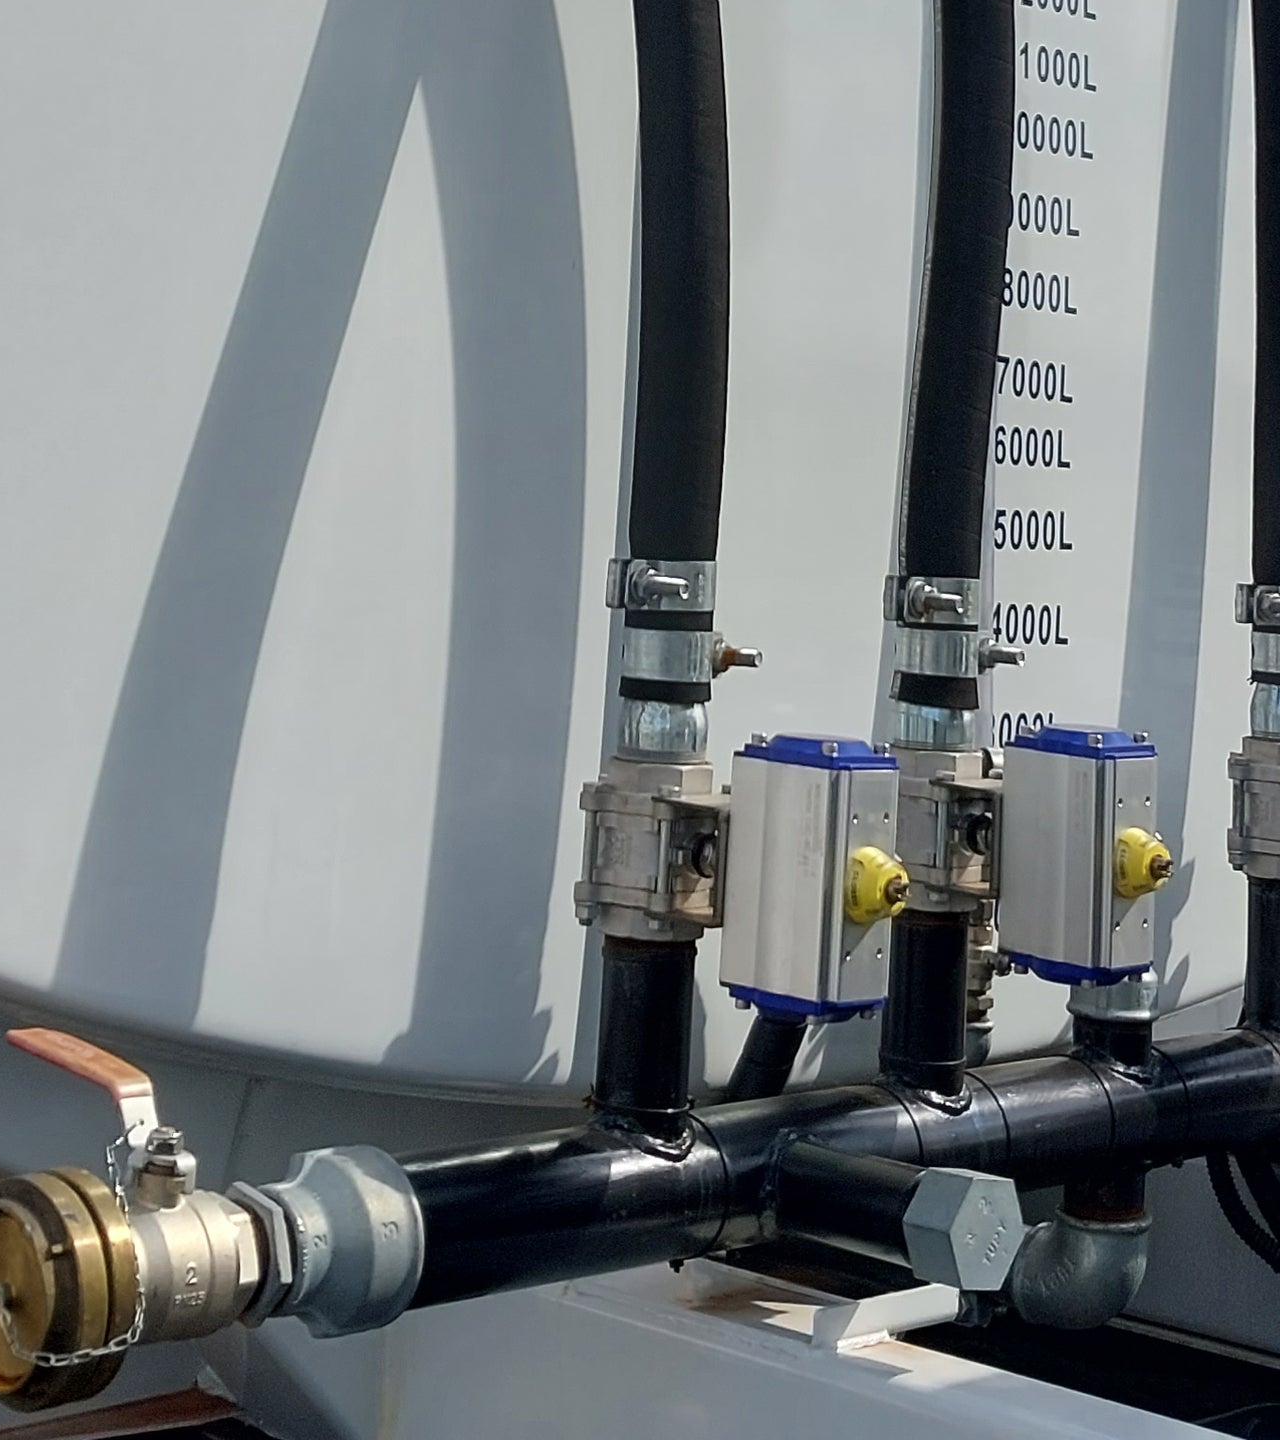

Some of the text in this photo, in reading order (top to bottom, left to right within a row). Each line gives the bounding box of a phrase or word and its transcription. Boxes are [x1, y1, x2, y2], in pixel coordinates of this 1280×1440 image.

[1007, 192, 1080, 237] 000L
[1002, 267, 1078, 315] 8000L
[997, 355, 1073, 404] 7000L
[994, 425, 1071, 469] 6000L
[993, 509, 1073, 551] 5000L
[184, 1260, 200, 1286] 2
